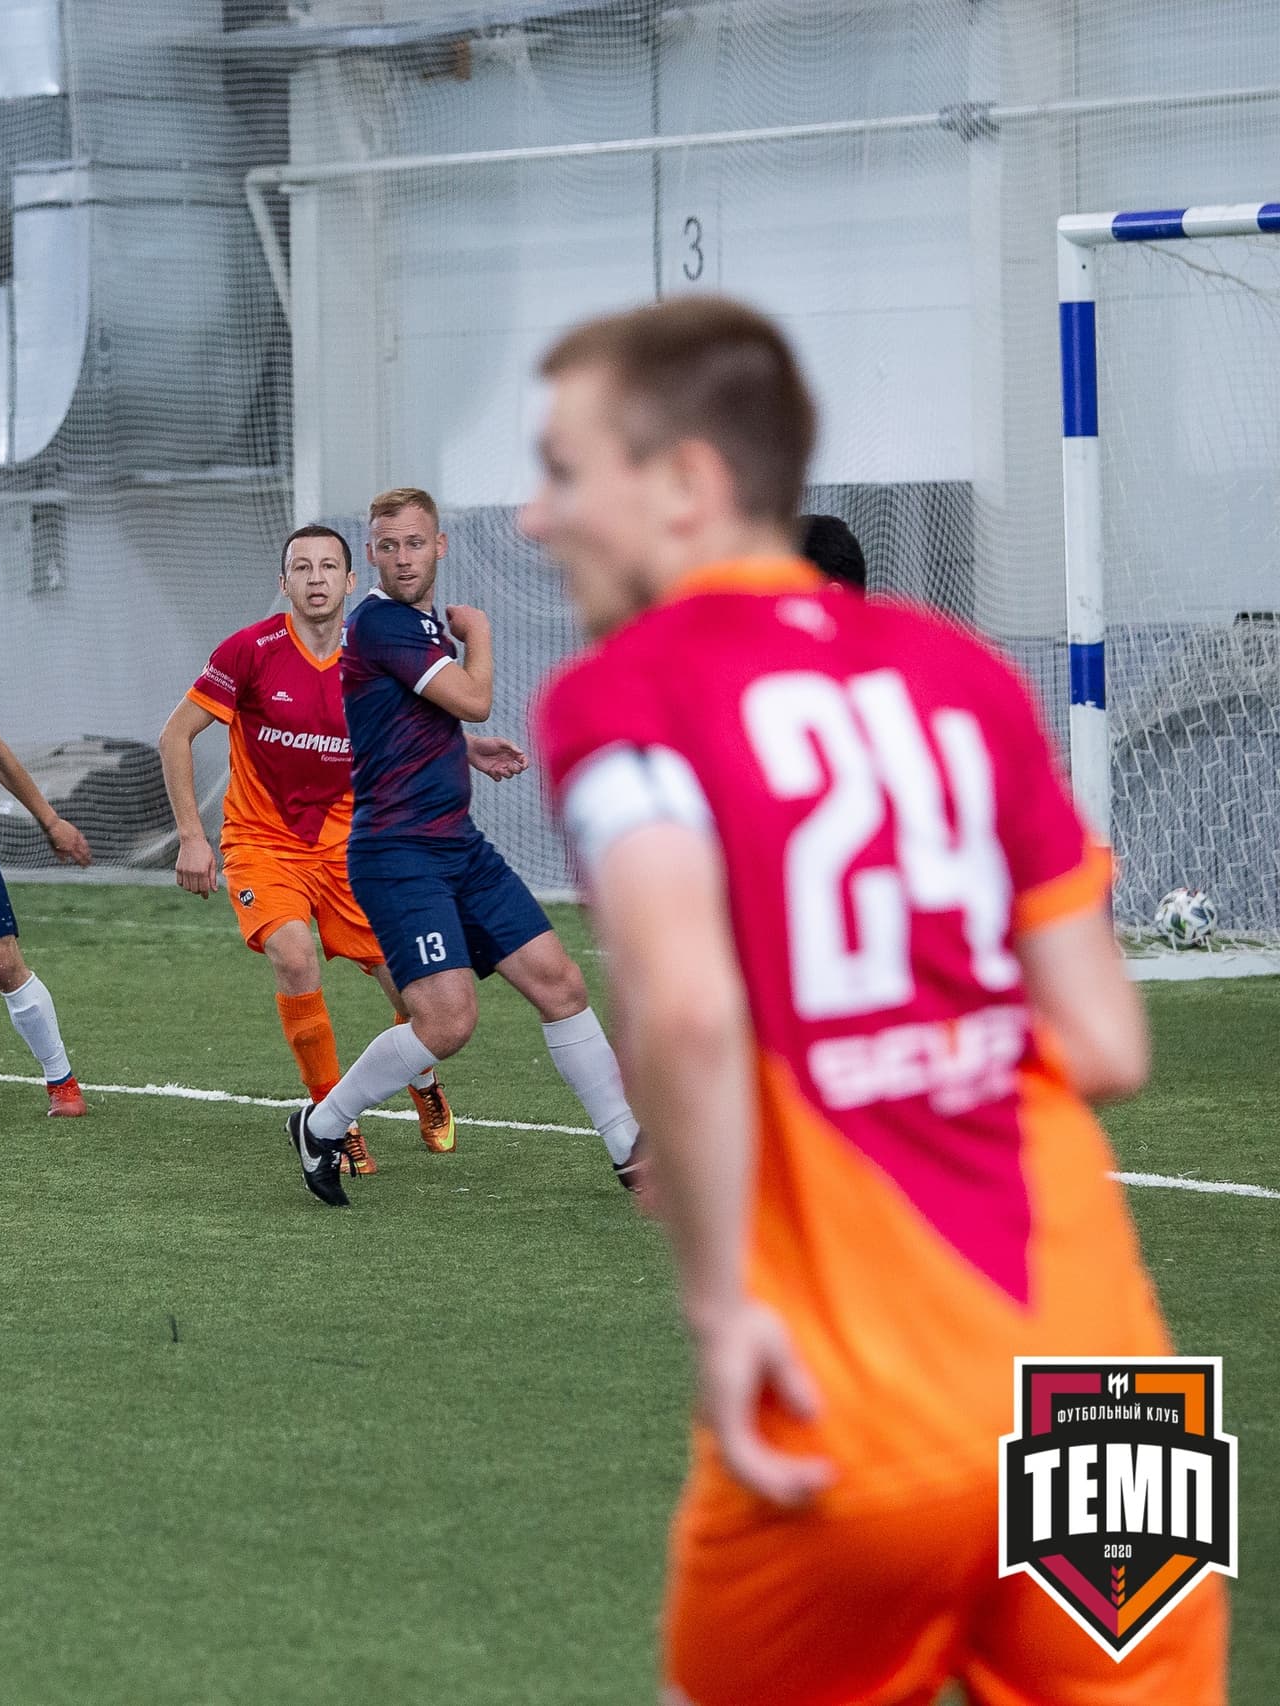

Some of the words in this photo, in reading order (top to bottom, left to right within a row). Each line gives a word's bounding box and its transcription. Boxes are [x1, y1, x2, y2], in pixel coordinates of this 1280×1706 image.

[683, 216, 704, 281] 3
[257, 725, 354, 754] ПРОДИНВЕ
[740, 667, 1021, 1023] 24
[415, 931, 447, 965] 13
